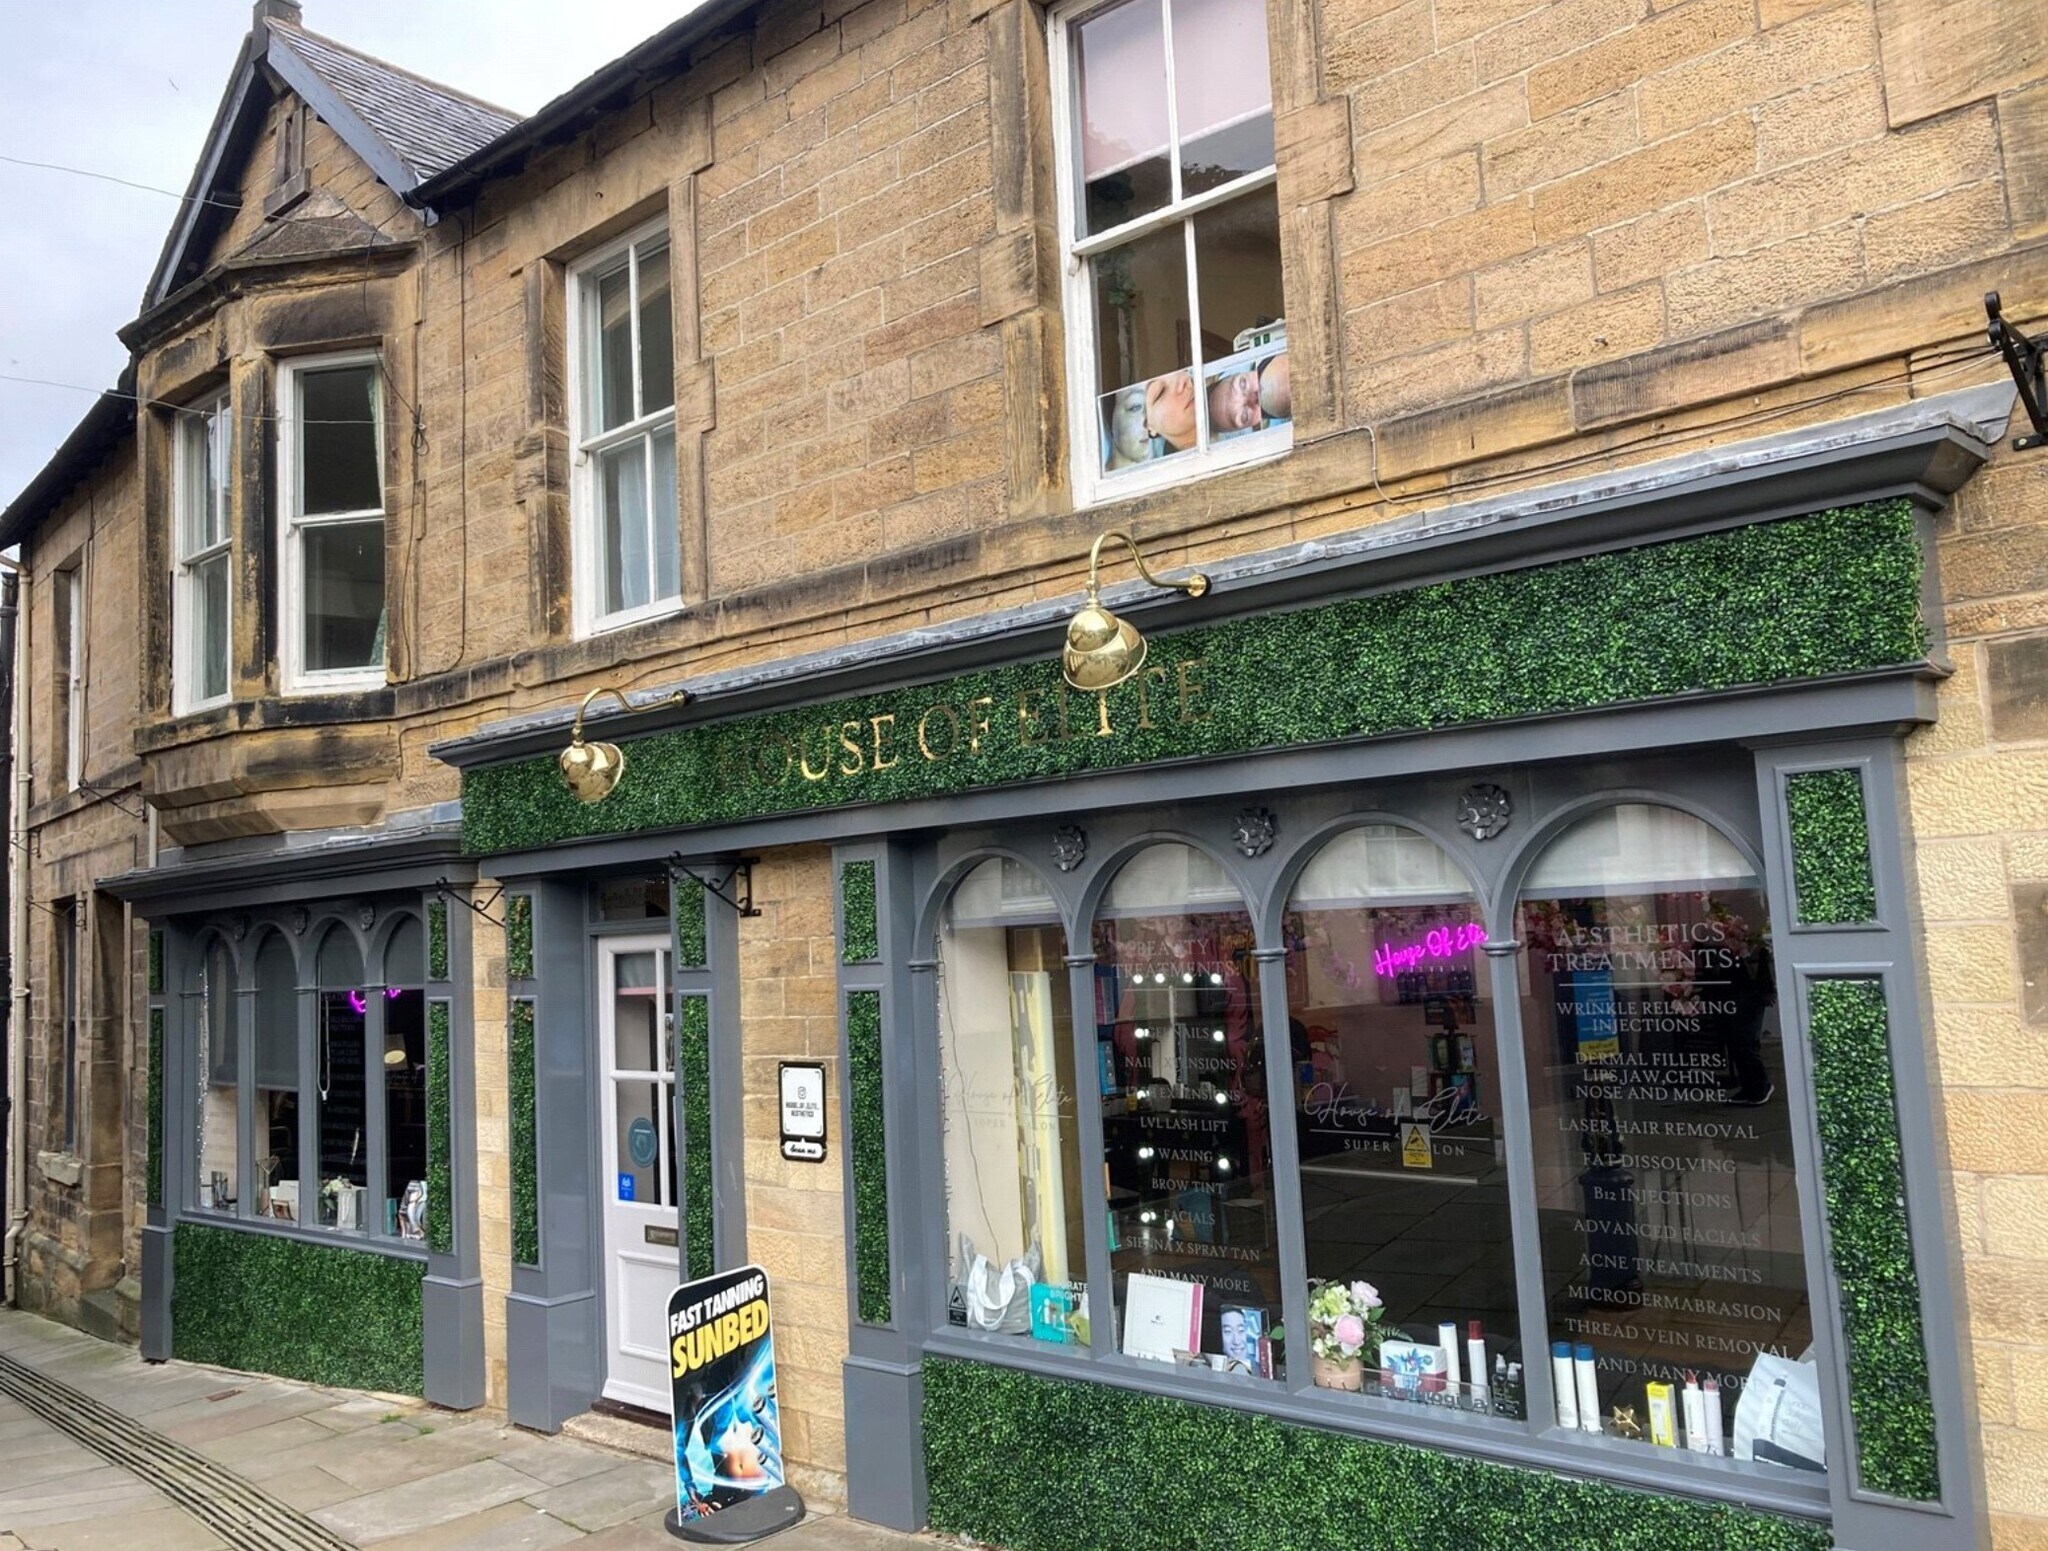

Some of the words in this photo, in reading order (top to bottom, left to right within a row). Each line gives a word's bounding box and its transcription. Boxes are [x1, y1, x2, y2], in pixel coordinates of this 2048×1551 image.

[918, 697, 993, 762] OF
[1017, 659, 1213, 747] ELITE
[1556, 922, 1726, 947] AESTHETICS
[1547, 949, 1741, 972] TREATMENTS:
[1557, 1001, 1636, 1016] WRINKLE
[1642, 1001, 1737, 1017] RELAXING
[1592, 1018, 1700, 1035] INJECTIONS
[1575, 1052, 1648, 1067] DERMAL
[1653, 1052, 1727, 1068] FILLERS:
[1575, 1085, 1624, 1100] NOSE
[1628, 1086, 1668, 1101] AND
[1140, 1116, 1163, 1130] LVL
[1165, 1117, 1198, 1132] LASH
[1201, 1119, 1229, 1133] LIFT
[1558, 1118, 1612, 1135] LASER
[1615, 1119, 1659, 1137] HAIR
[1665, 1122, 1759, 1140] REMOVAL
[1158, 1148, 1213, 1163] WAXING
[1344, 1138, 1391, 1153] SUPER
[1583, 1153, 1620, 1168] FAT
[1620, 1154, 1737, 1174] DISSOLVING
[1152, 1178, 1189, 1192] BROW
[1192, 1180, 1225, 1195] TINT
[1594, 1186, 1616, 1201] B12
[1621, 1188, 1732, 1209] INJECTIONS
[1164, 1209, 1216, 1226] FACIALS
[1573, 1219, 1677, 1240] ADVANCED
[1682, 1227, 1762, 1247] FACIALS
[1126, 1236, 1173, 1251] SIENNA
[1176, 1240, 1185, 1252] X
[1187, 1242, 1232, 1259] SPRAY
[1232, 1247, 1261, 1262] TAN
[1579, 1252, 1630, 1270] ACNE
[1632, 1257, 1762, 1284] TREATMENTS
[1212, 1276, 1251, 1293] MORE
[670, 1302, 702, 1338] FAST
[704, 1274, 764, 1320] TANNING
[1568, 1284, 1782, 1322] MICRODERMABRASION
[672, 1299, 769, 1379] SUNBED
[1565, 1317, 1639, 1340] THREAD
[1643, 1327, 1690, 1347] VEIN
[1695, 1334, 1794, 1360] REMOVAL
[1597, 1356, 1638, 1374] AND
[1642, 1364, 1699, 1382] MANY
[1706, 1371, 1760, 1391] MOR
